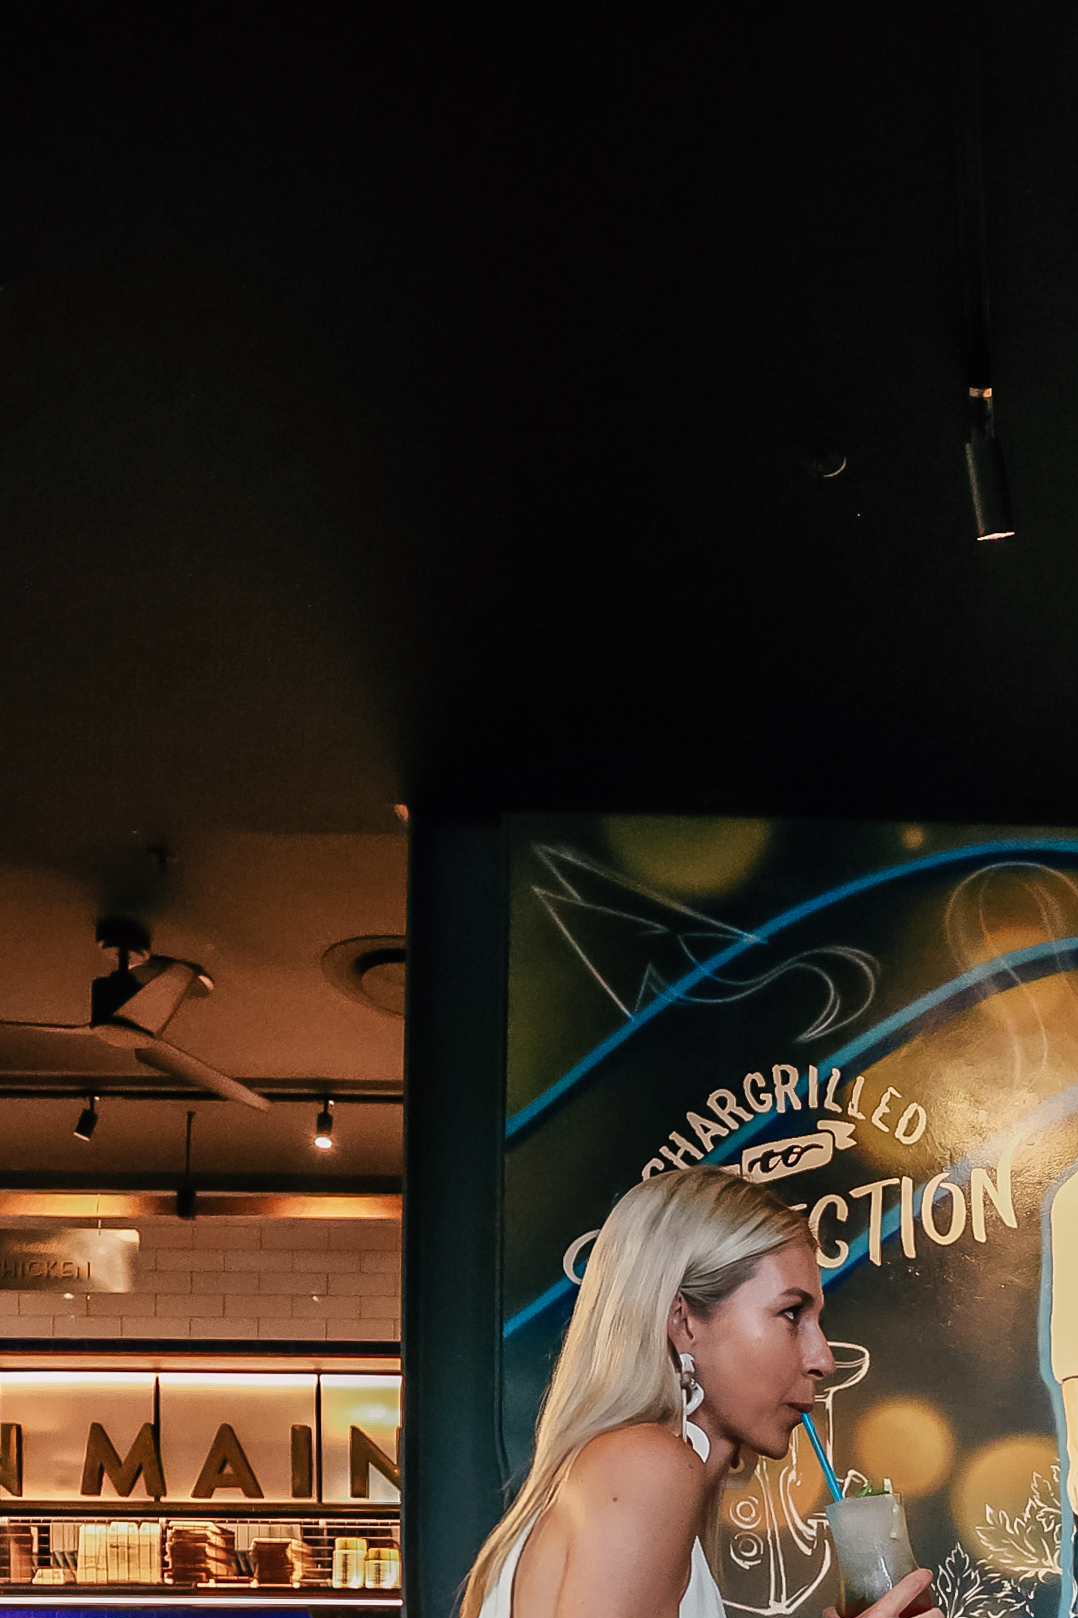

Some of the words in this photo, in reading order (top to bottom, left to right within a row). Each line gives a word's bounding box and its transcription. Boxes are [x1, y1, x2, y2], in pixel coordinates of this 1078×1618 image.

[641, 1064, 927, 1182] CHARGRILLED
[747, 1144, 824, 1174] to
[0, 1259, 91, 1279] HICKEN
[80, 1421, 401, 1499] MAIN
